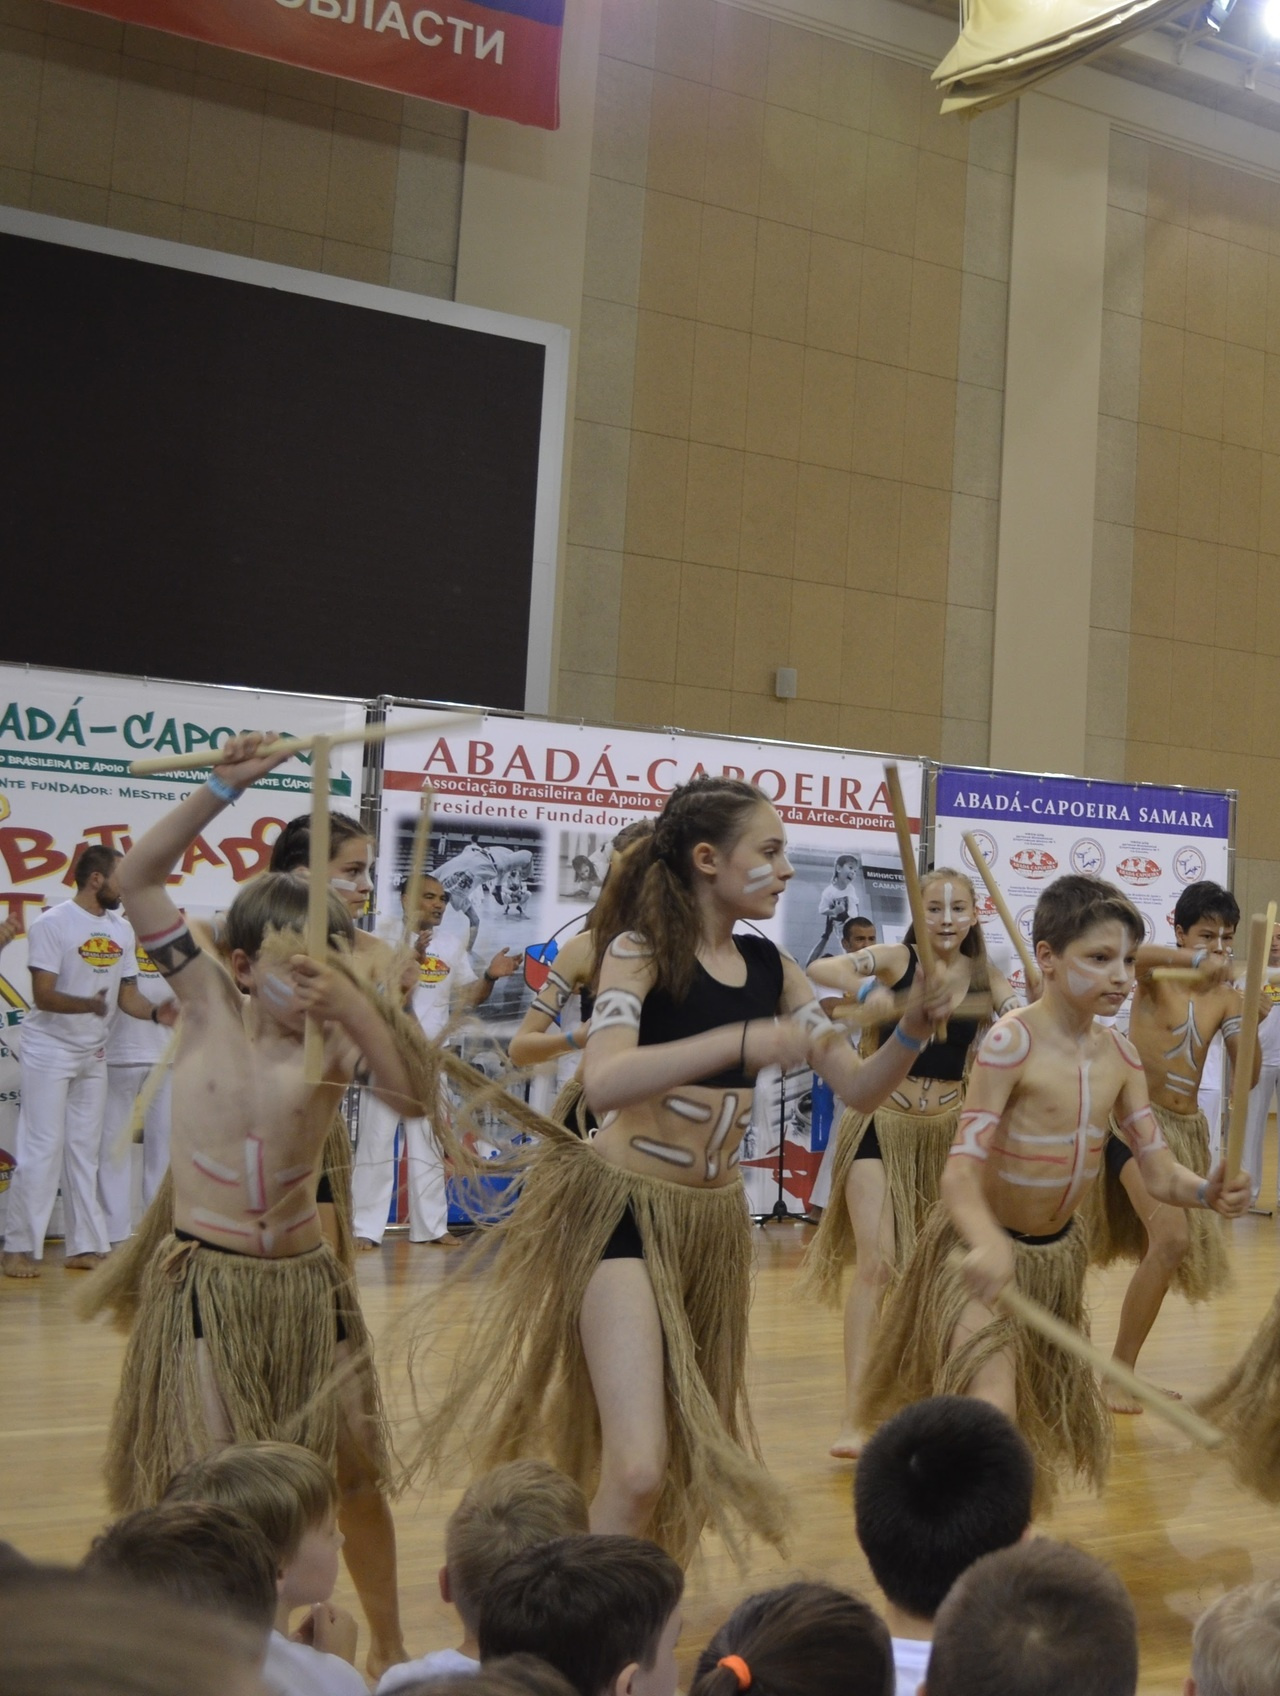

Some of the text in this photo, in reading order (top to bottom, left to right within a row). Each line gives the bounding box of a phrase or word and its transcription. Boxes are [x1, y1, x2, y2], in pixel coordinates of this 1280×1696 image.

[275, 0, 505, 65] БЛАСТИ
[8, 755, 72, 770] BRASILEIRA
[74, 761, 90, 770] DE
[92, 763, 124, 773] APOIO
[31, 781, 113, 796] FUNDADOR:
[118, 787, 176, 801] MESTRE
[422, 775, 507, 796] Associação
[512, 783, 582, 801] Brasileira
[586, 789, 604, 803] de
[608, 791, 651, 808] Apoio
[655, 798, 663, 808] e
[788, 809, 803, 820] da
[807, 811, 896, 829] Arte-Capoeira
[420, 797, 528, 819] Presidente
[953, 790, 1215, 828] ABADÁ-CAPOEIRA SAMARA
[866, 871, 905, 881] МИНИСТЕ
